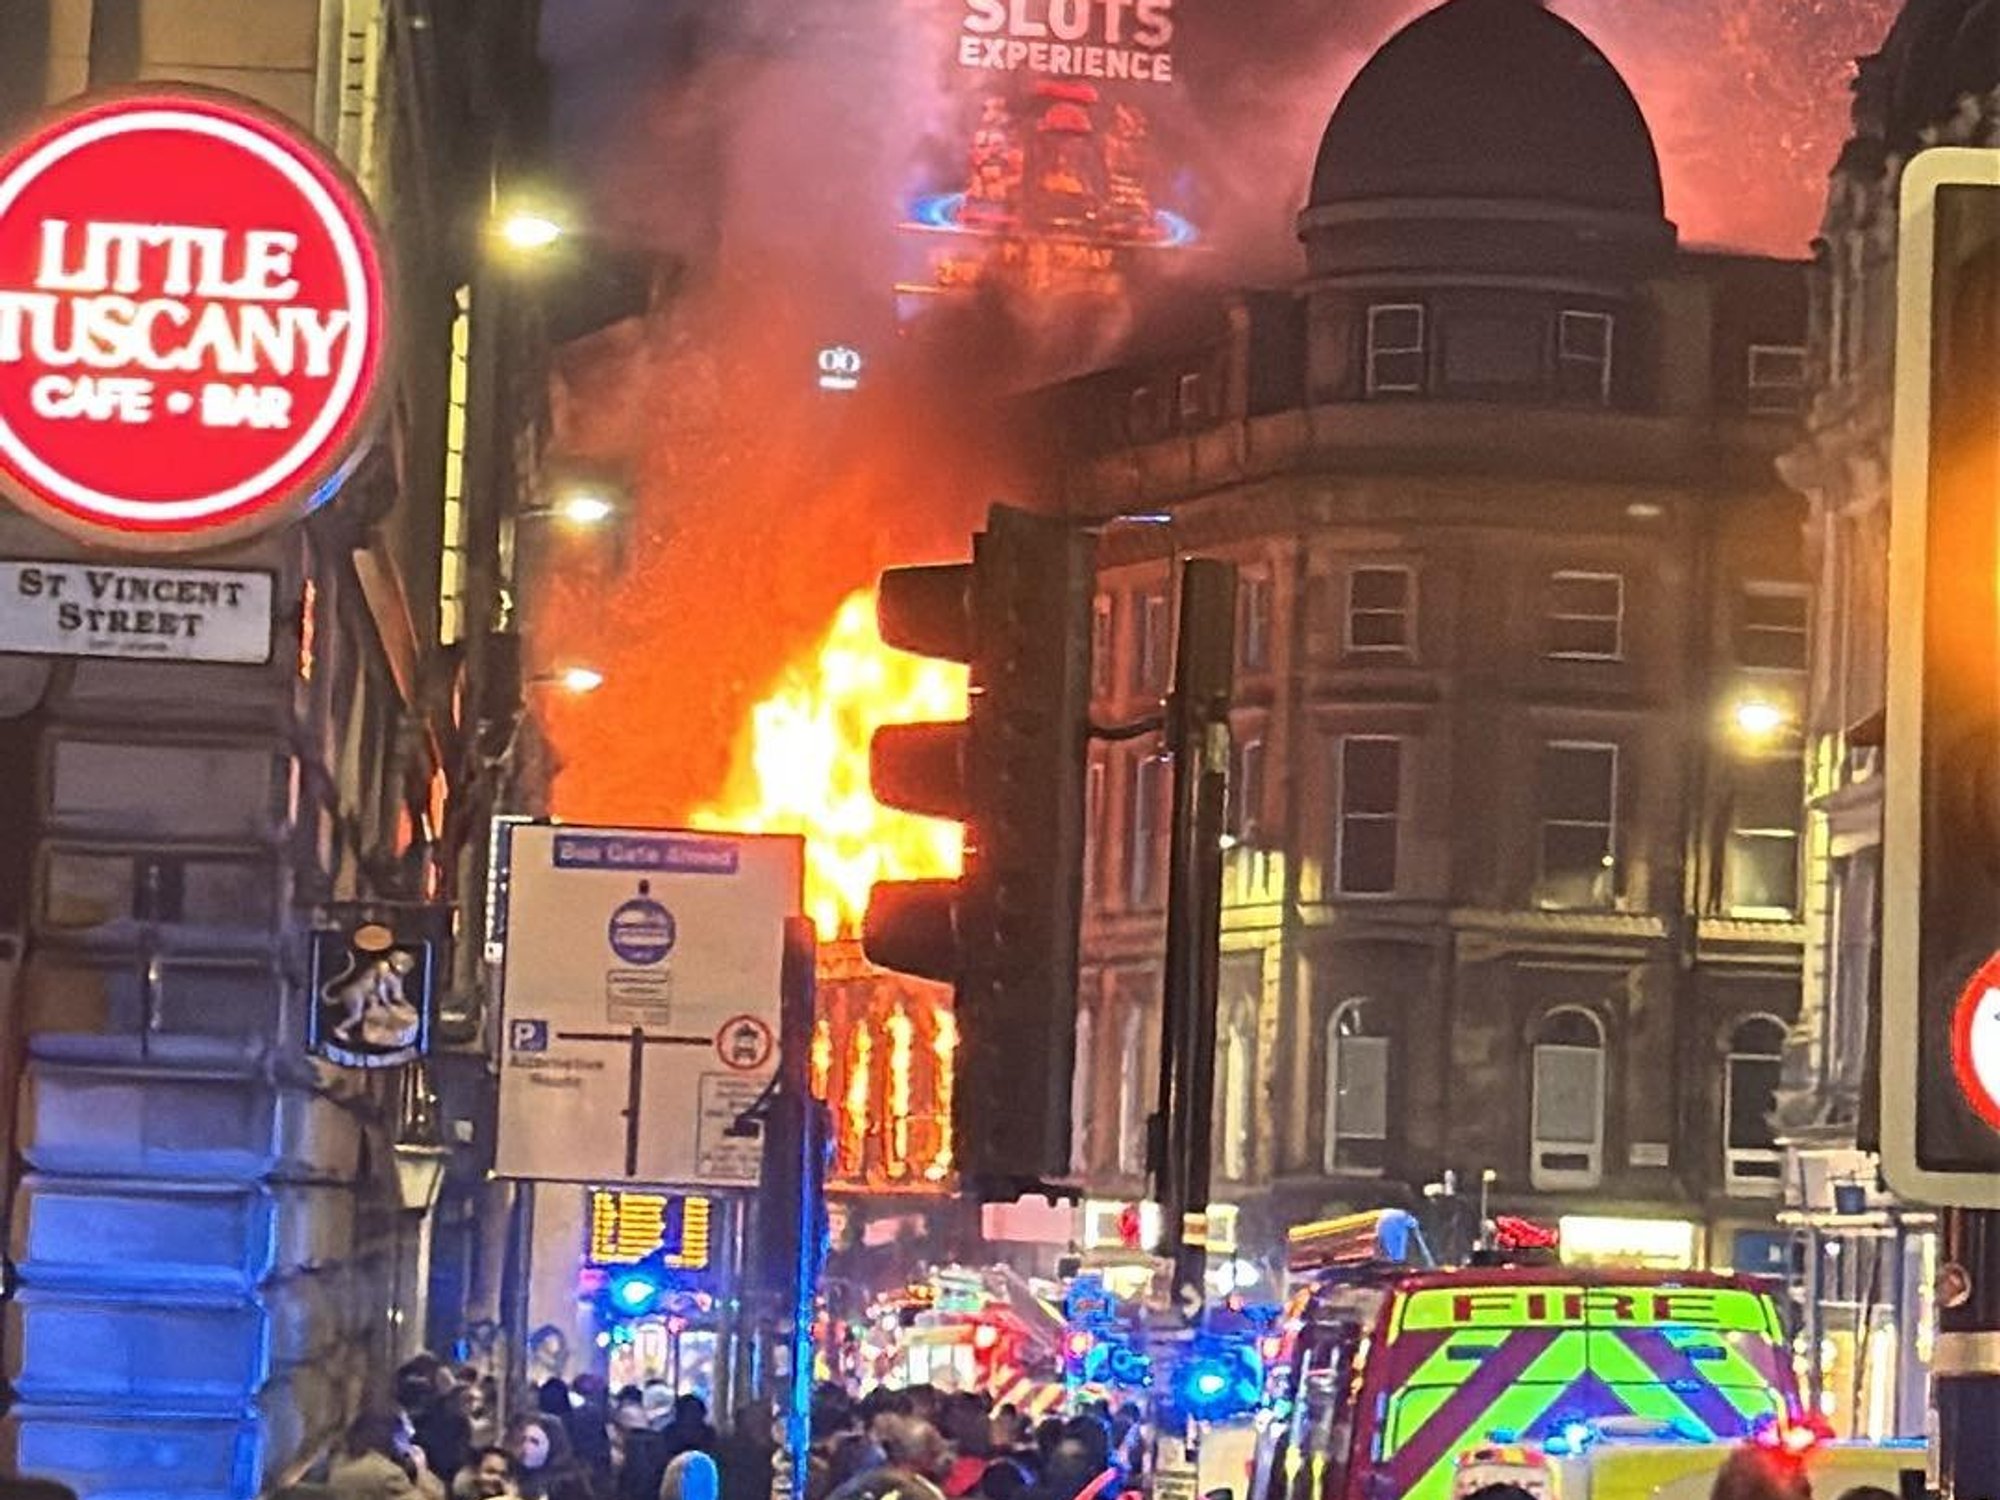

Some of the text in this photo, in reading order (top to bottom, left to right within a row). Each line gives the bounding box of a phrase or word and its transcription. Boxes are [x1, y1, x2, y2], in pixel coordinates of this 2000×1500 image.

[963, 0, 1173, 48] SLOTS
[959, 35, 1173, 81] EXPERIENCE
[34, 219, 299, 301] LITTLE
[0, 290, 350, 377] TUSCANY
[31, 374, 293, 429] CAFE BAR
[86, 570, 245, 607] VINCENT
[57, 602, 204, 637] STREET
[514, 1022, 536, 1050] P
[1453, 1292, 1720, 1323] FIRE
